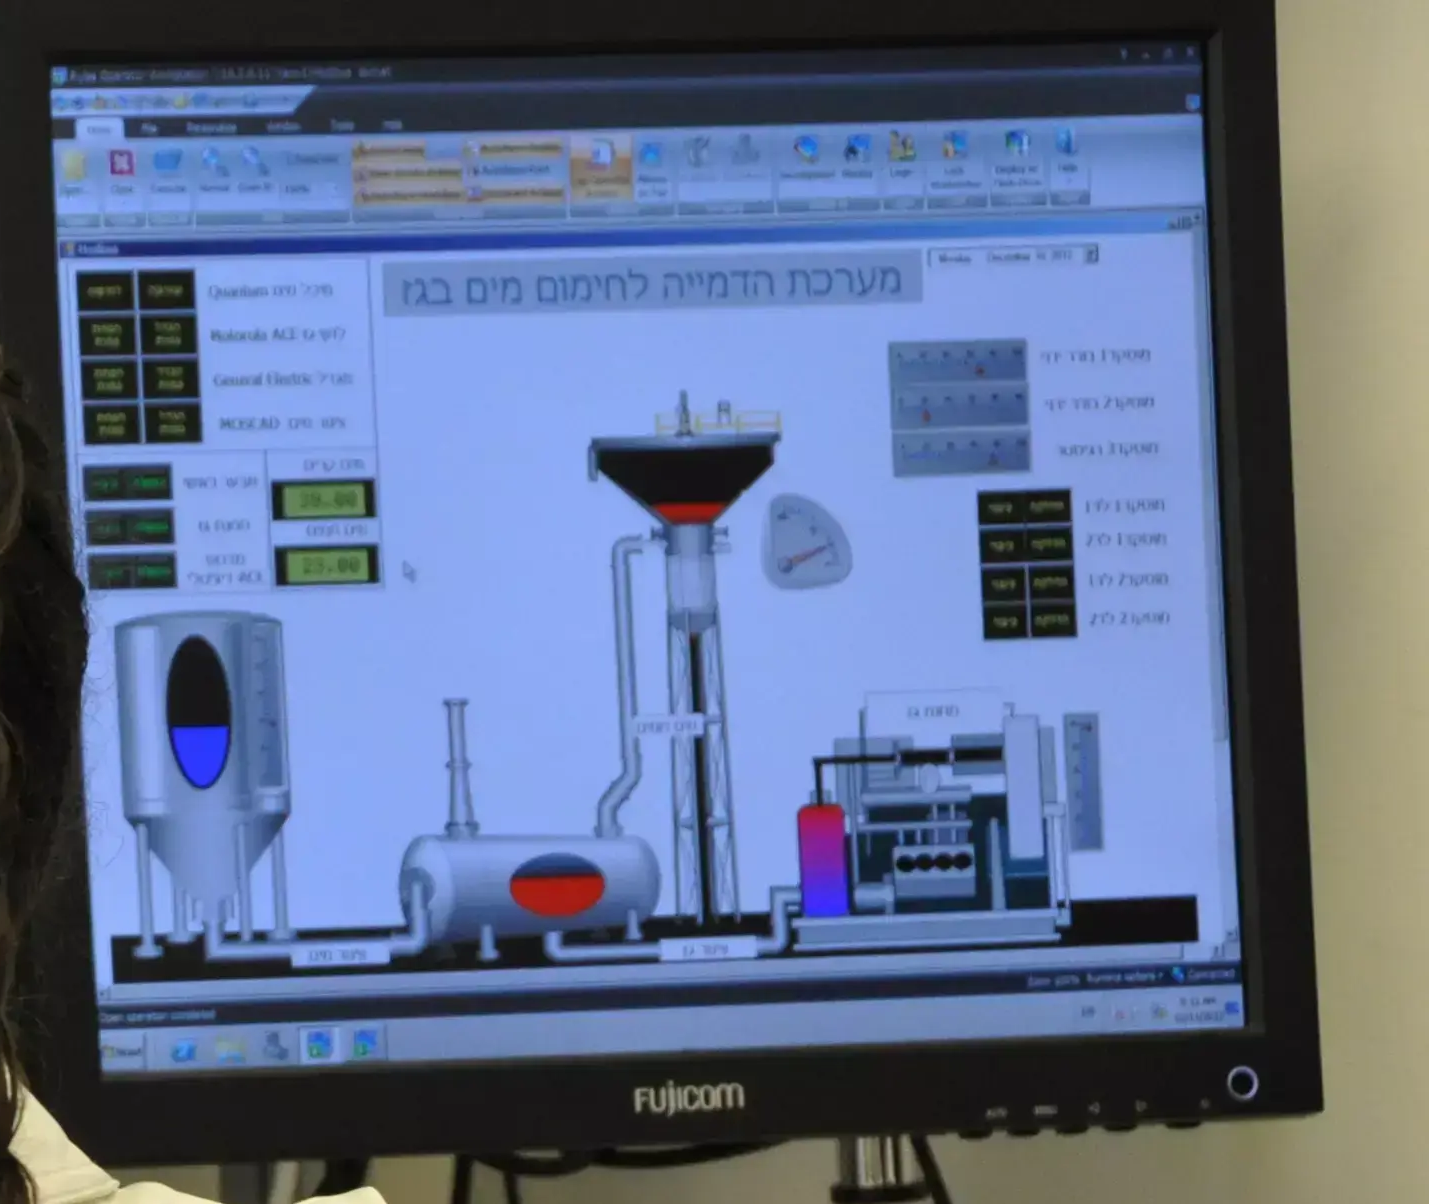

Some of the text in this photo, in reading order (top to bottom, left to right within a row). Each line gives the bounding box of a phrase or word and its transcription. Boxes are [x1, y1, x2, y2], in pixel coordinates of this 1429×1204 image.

[402, 263, 902, 309] מערכת הדמייה לחימום מים בגז
